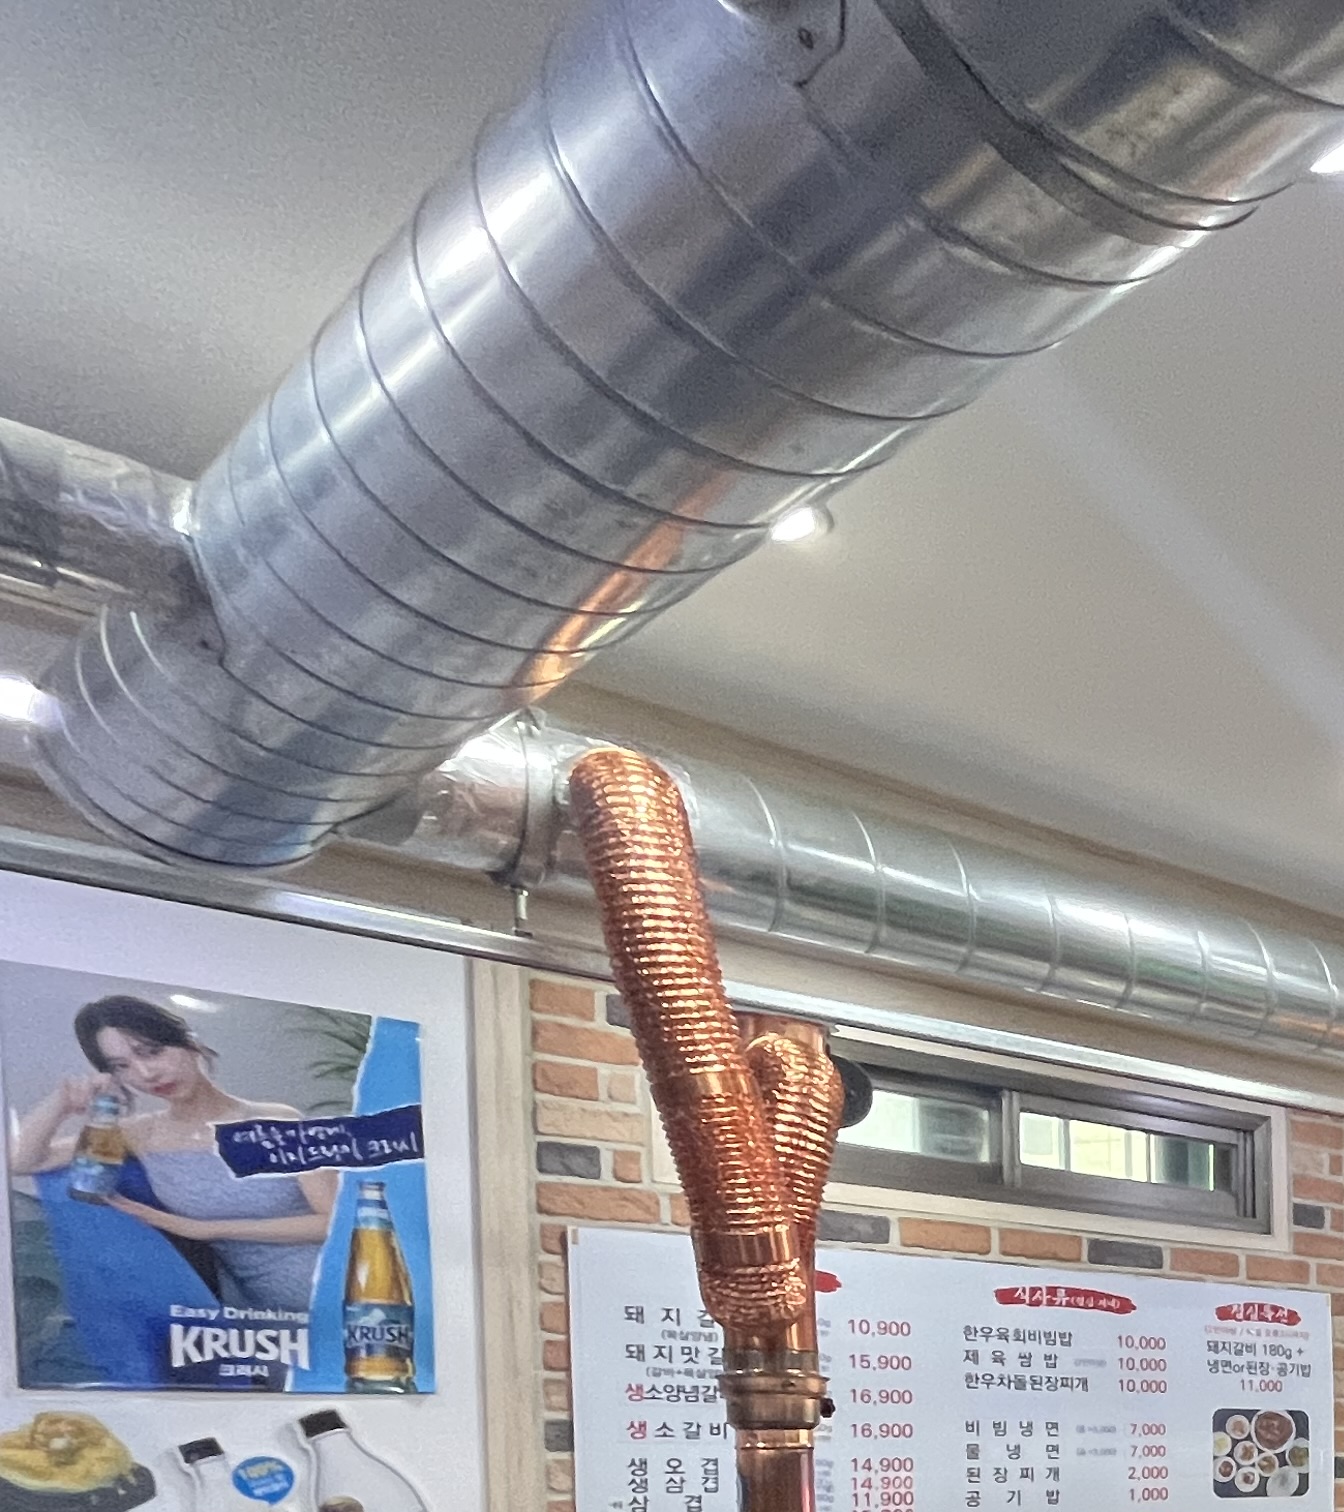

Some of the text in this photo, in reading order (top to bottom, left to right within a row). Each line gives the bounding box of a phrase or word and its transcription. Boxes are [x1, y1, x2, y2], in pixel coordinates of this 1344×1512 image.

[169, 1304, 309, 1324] Easy Drinking
[963, 1325, 1073, 1348] 한우육회비빔밥
[169, 1323, 311, 1371] KRUSH
[1206, 1339, 1257, 1357] 돼지갈비
[1130, 1423, 1167, 1438] 7,000
[1130, 1444, 1167, 1459] 7,000
[1128, 1465, 1169, 1481] 2,000
[1130, 1486, 1169, 1504] 1,000
